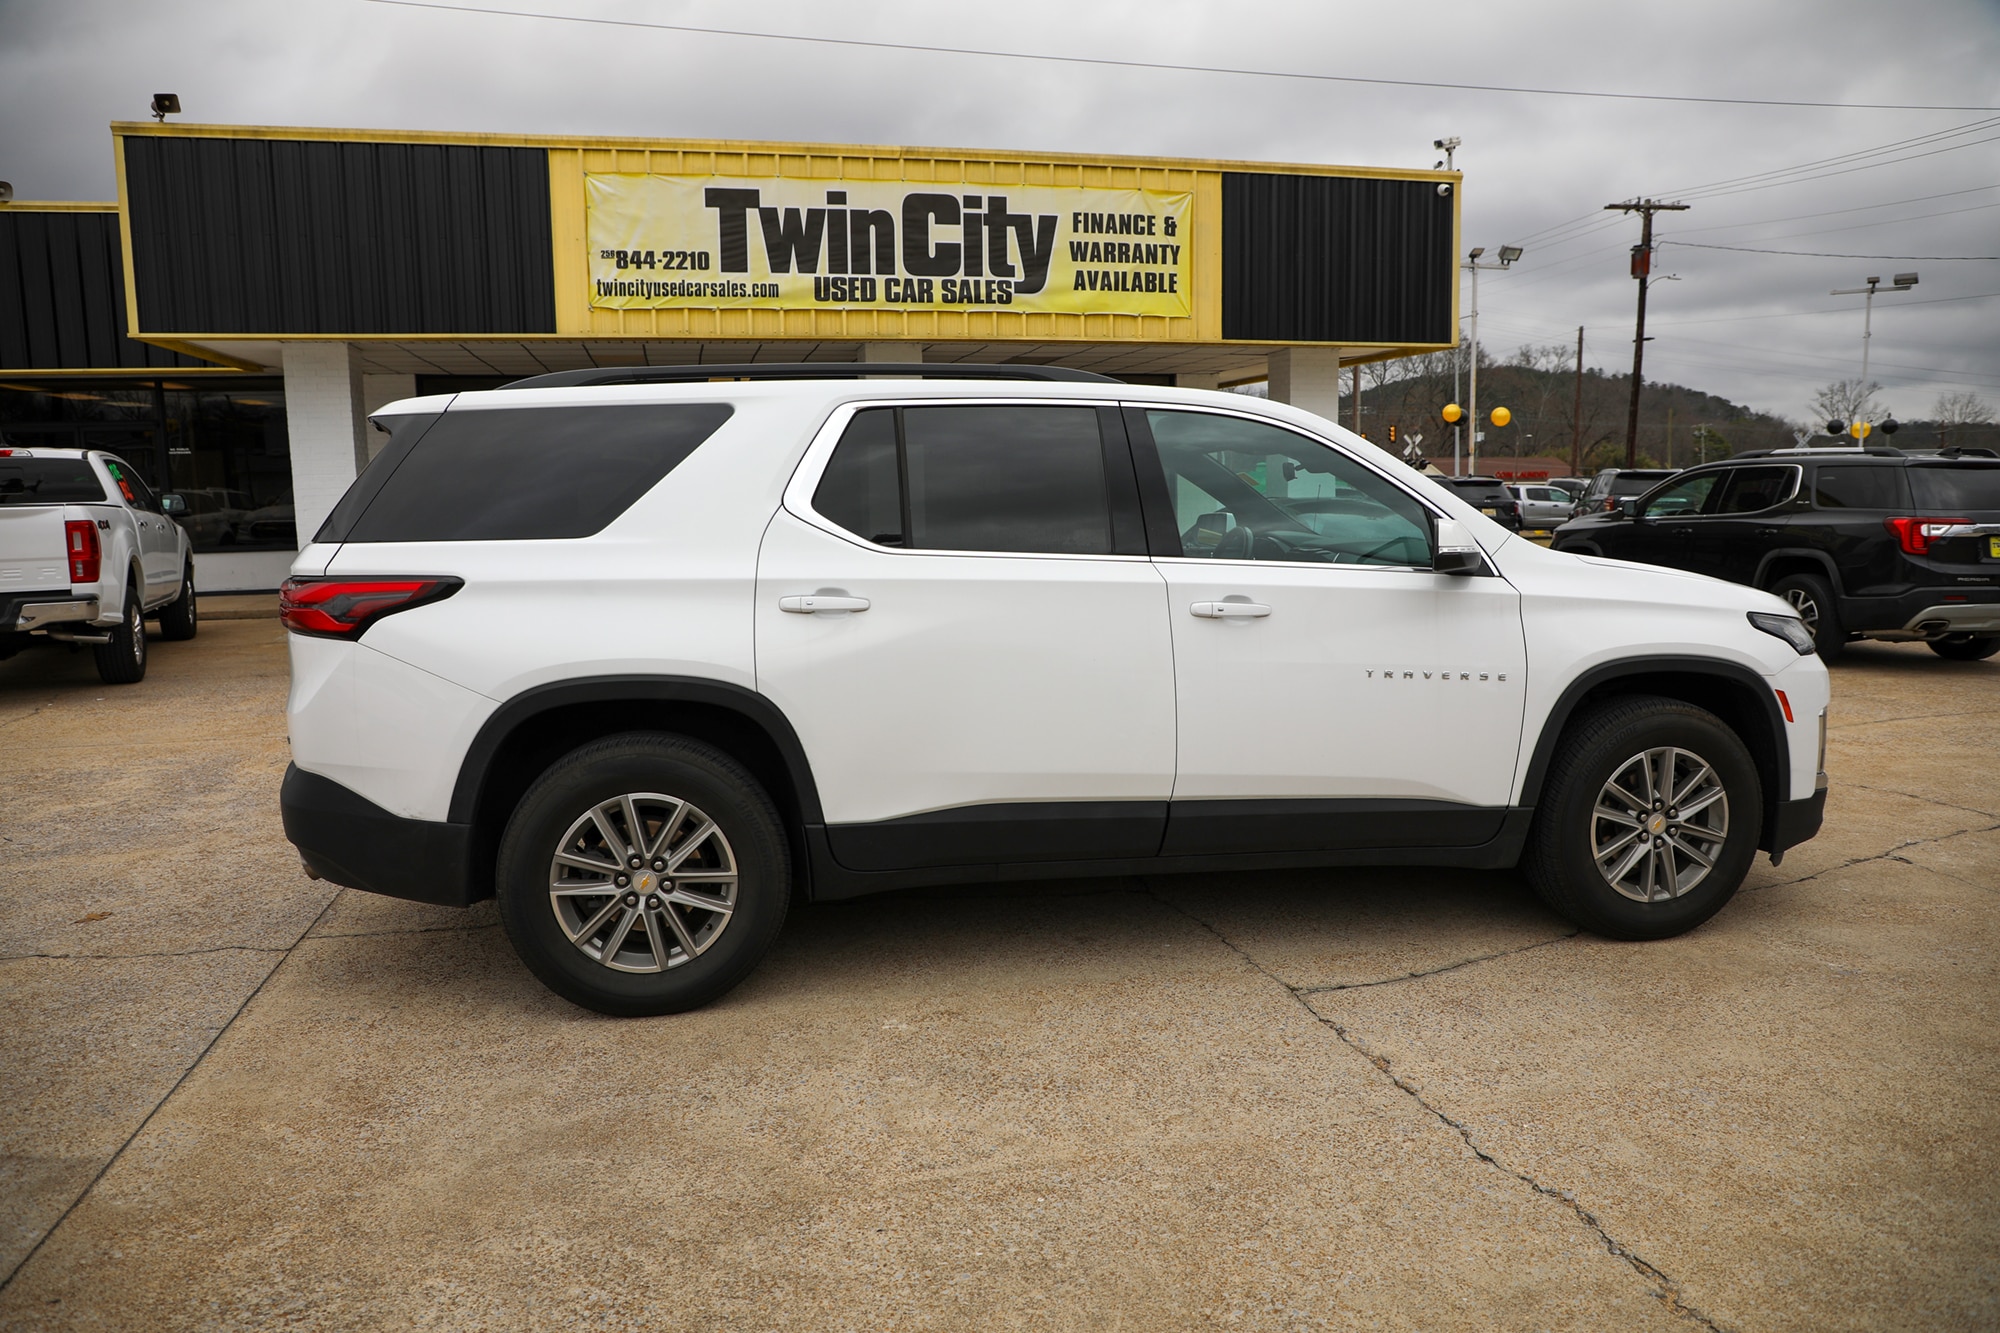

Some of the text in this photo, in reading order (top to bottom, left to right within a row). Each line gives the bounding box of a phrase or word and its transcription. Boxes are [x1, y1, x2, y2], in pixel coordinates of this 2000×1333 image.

[1073, 212, 1177, 237] FINANCE &
[615, 250, 710, 270] 844-2210
[1069, 241, 1180, 265] WARRANTY
[597, 279, 780, 300] twincityusedcarsales.com
[814, 276, 1013, 304] USED CAR SALES
[1073, 270, 1178, 293] AVAILABLE
[1366, 668, 1507, 682] TRAVERSE
